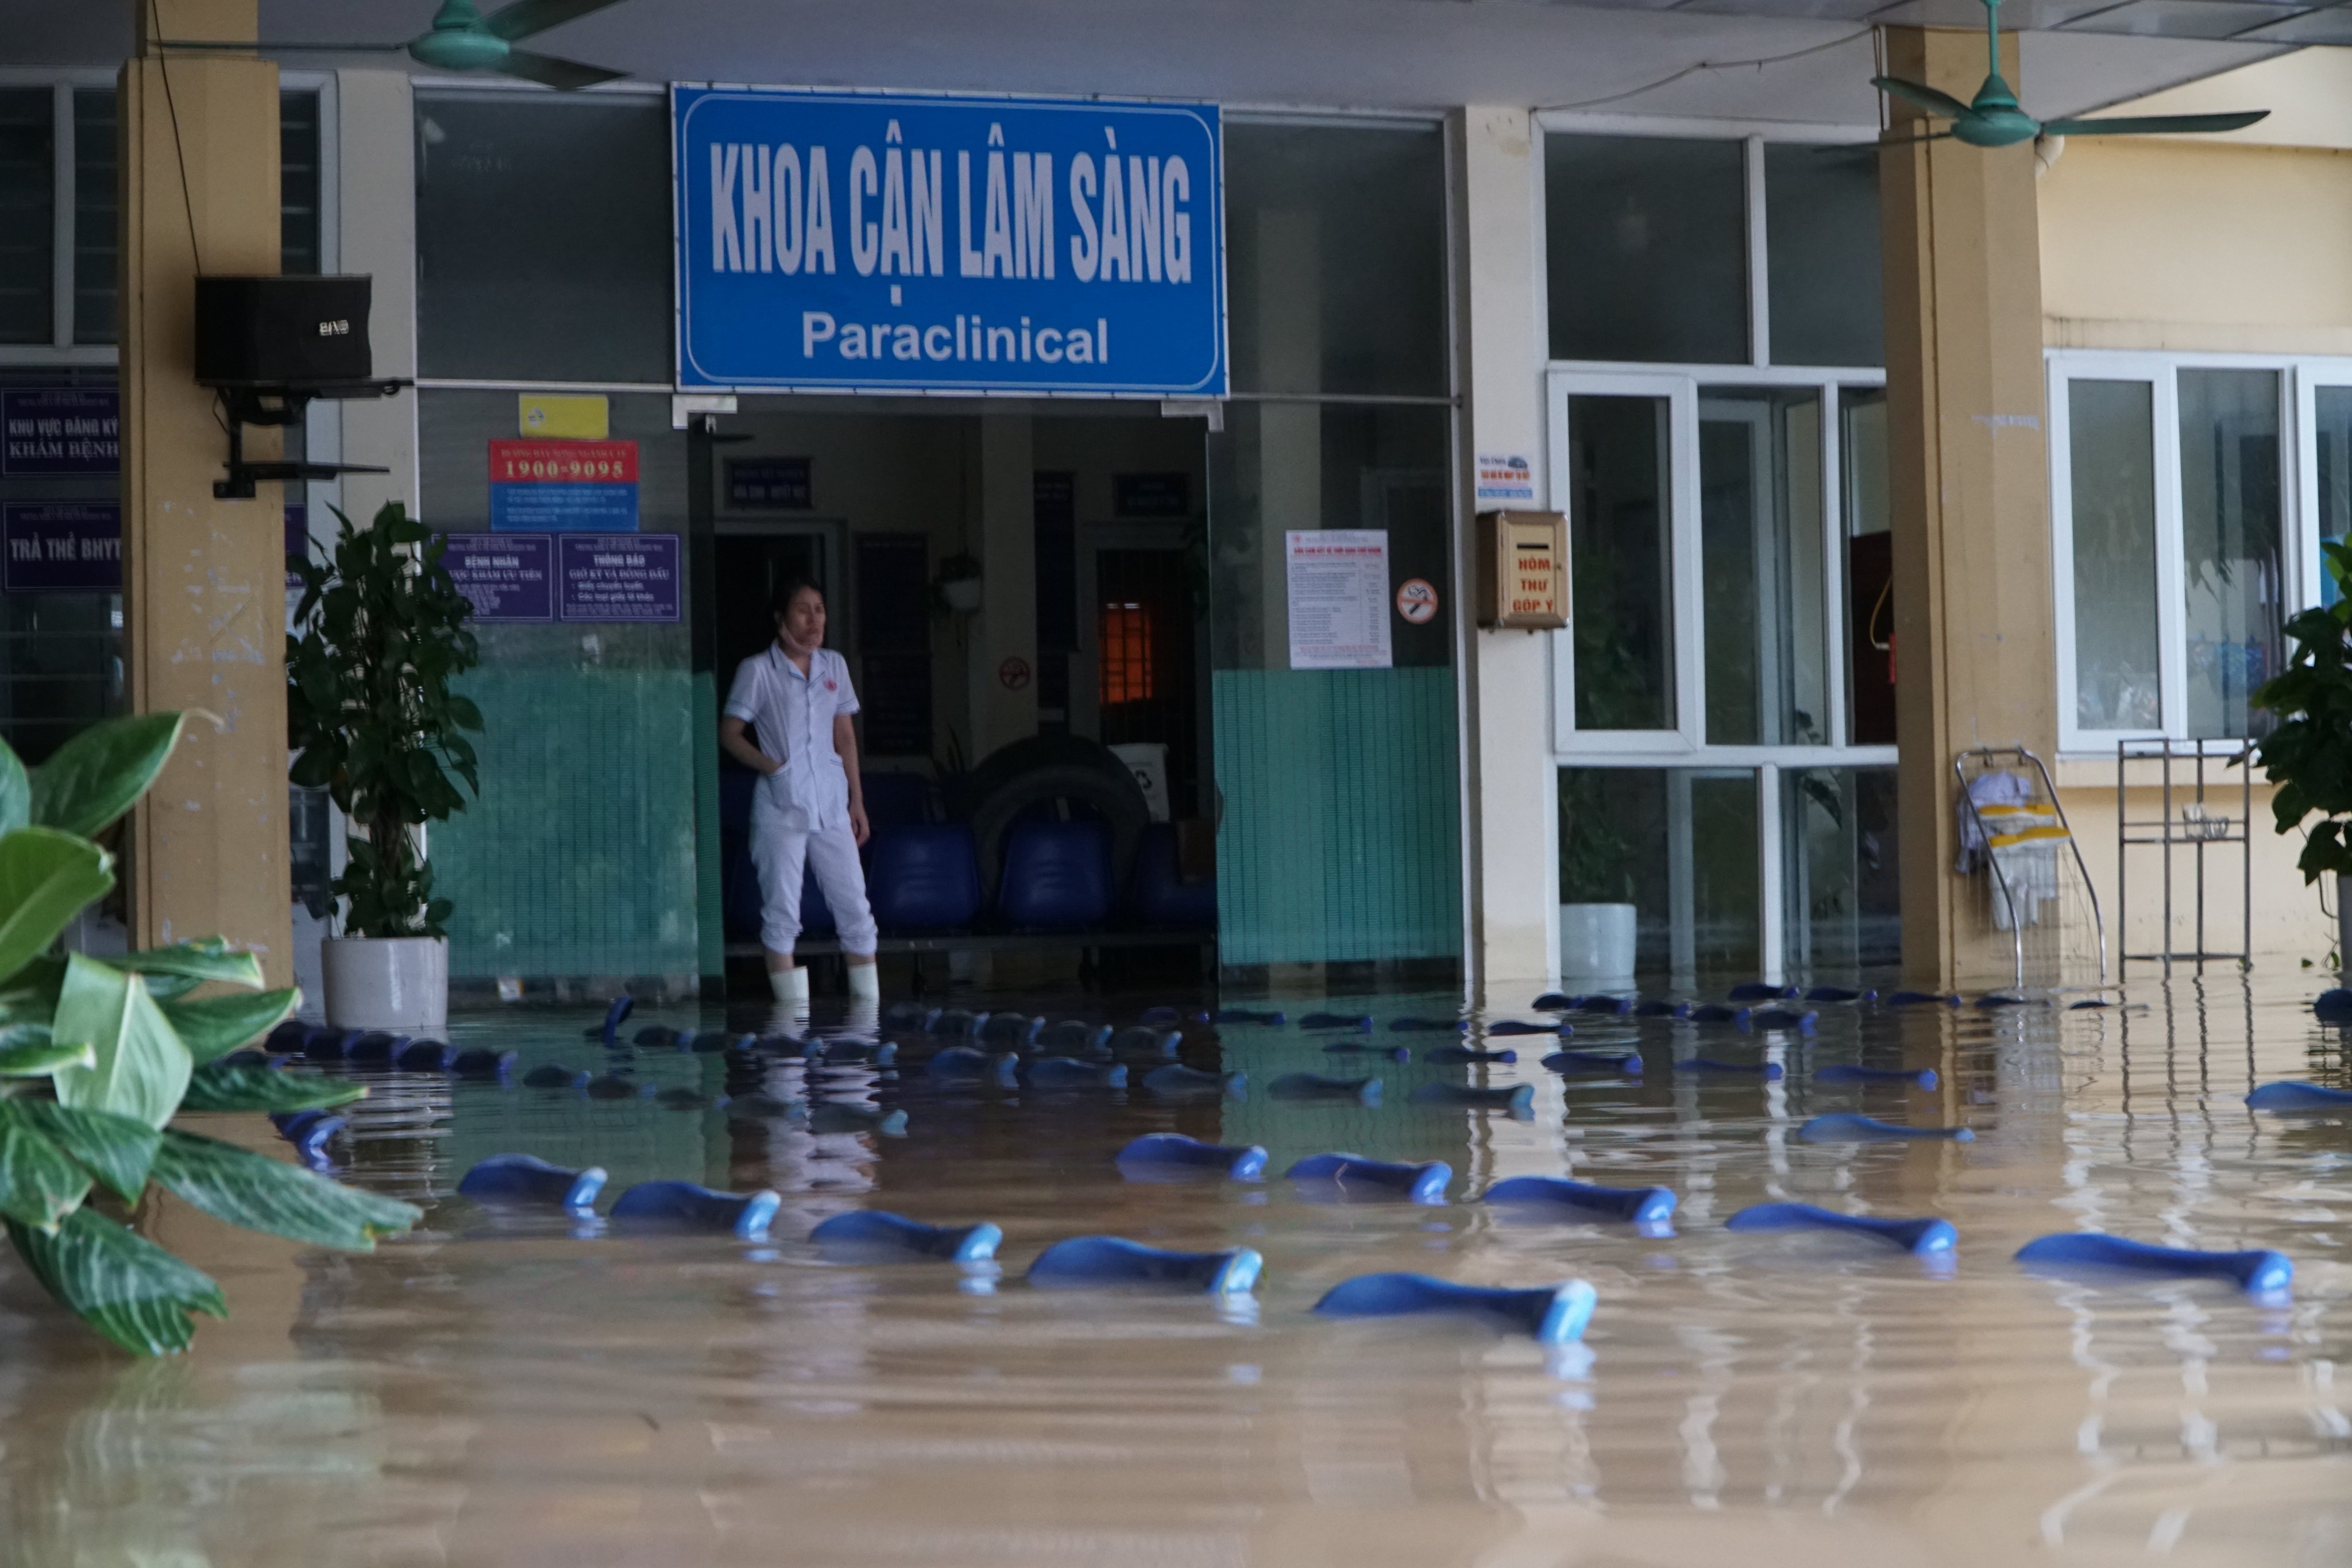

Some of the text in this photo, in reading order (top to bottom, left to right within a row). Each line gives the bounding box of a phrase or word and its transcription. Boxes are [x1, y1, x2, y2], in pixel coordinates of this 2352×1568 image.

[710, 119, 1192, 306] KHOA CẬN LÂM SÀNG
[803, 311, 1109, 364] Paraclinical
[9, 419, 34, 437] KHU
[37, 417, 62, 438] VỰC
[65, 416, 99, 437] ĐĂNG
[9, 438, 119, 461] KHÁM BỆNH
[10, 531, 43, 561] TRẢ
[46, 531, 76, 561] THẺ
[1518, 555, 1551, 571] HÒM
[1520, 578, 1548, 592] THƯ
[1513, 597, 1554, 612] GÓP Ý
